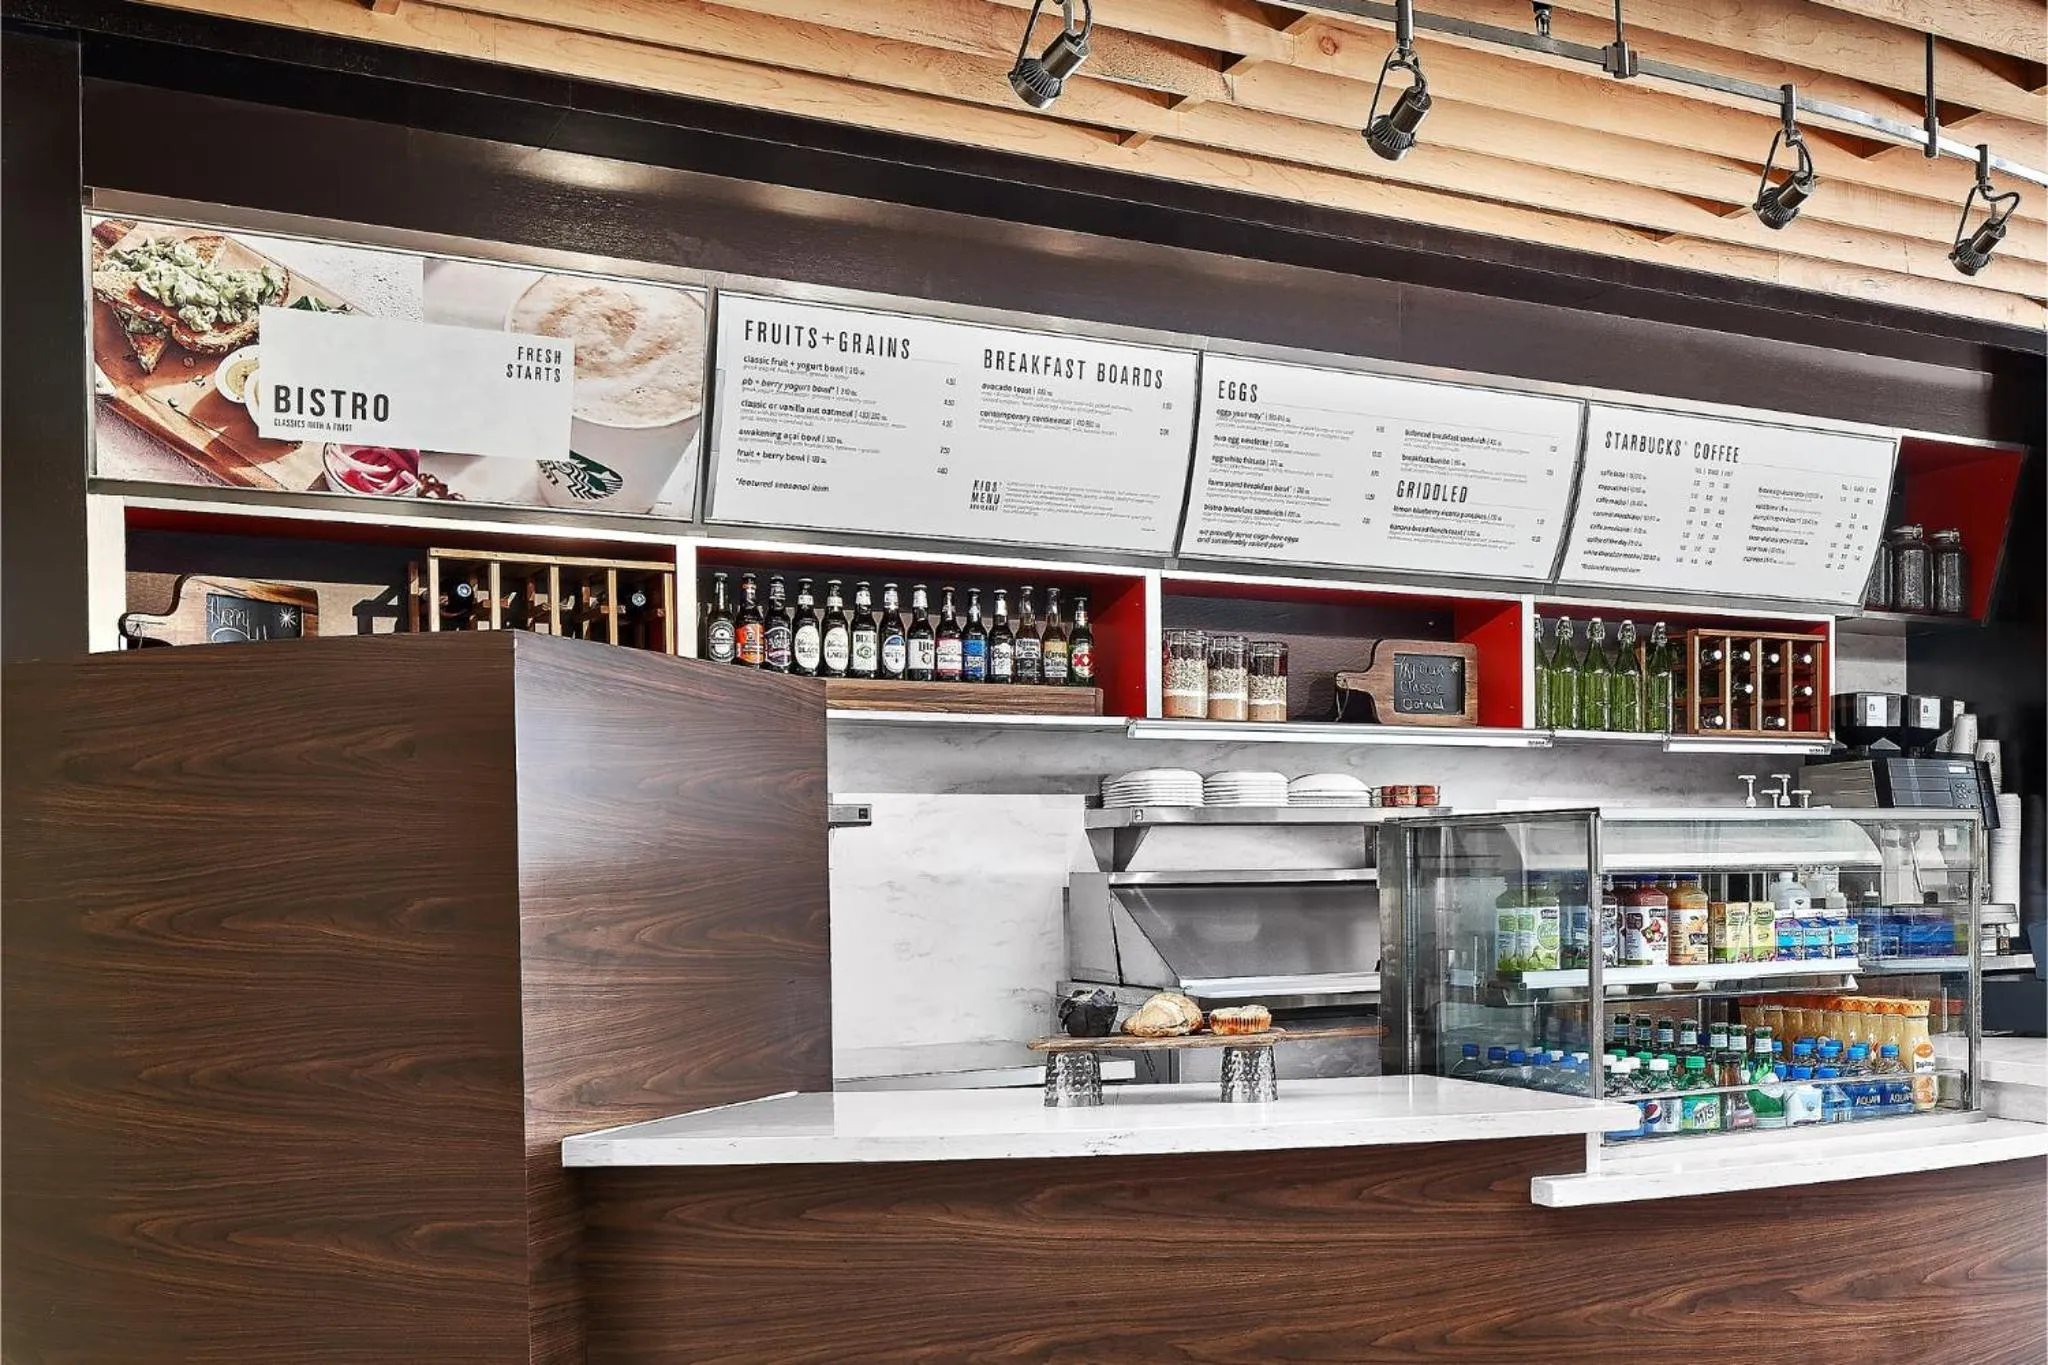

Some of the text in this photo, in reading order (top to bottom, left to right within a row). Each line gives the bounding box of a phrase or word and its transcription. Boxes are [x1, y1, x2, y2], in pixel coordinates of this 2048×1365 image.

[744, 319, 911, 360] FRUITS+GRAINS
[517, 345, 562, 365] FRESH
[743, 355, 770, 366] classic
[770, 356, 789, 368] fruit
[796, 361, 823, 373] yogurt
[824, 364, 844, 374] bowl
[505, 363, 562, 383] STARTS
[983, 348, 1164, 390] BREAKFAST BOARDS
[761, 379, 783, 391] berry
[783, 381, 811, 393] yogurt
[981, 383, 1032, 395] avocado toast
[1218, 379, 1259, 403] EGGS
[273, 384, 390, 423] BISTRO
[740, 400, 768, 410] classic
[778, 402, 806, 413] vanilla
[821, 407, 854, 418] oatmeal
[273, 418, 306, 429] CLASSICS
[738, 427, 782, 441] awakening
[801, 432, 821, 443] bowl
[736, 448, 755, 459] fruit
[762, 450, 785, 462] berry
[786, 452, 806, 463] bowl
[1693, 441, 1741, 464] COFFEE
[775, 480, 811, 492] seasonal
[1396, 479, 1469, 503] GRIDDLED
[971, 491, 1001, 505] MENU
